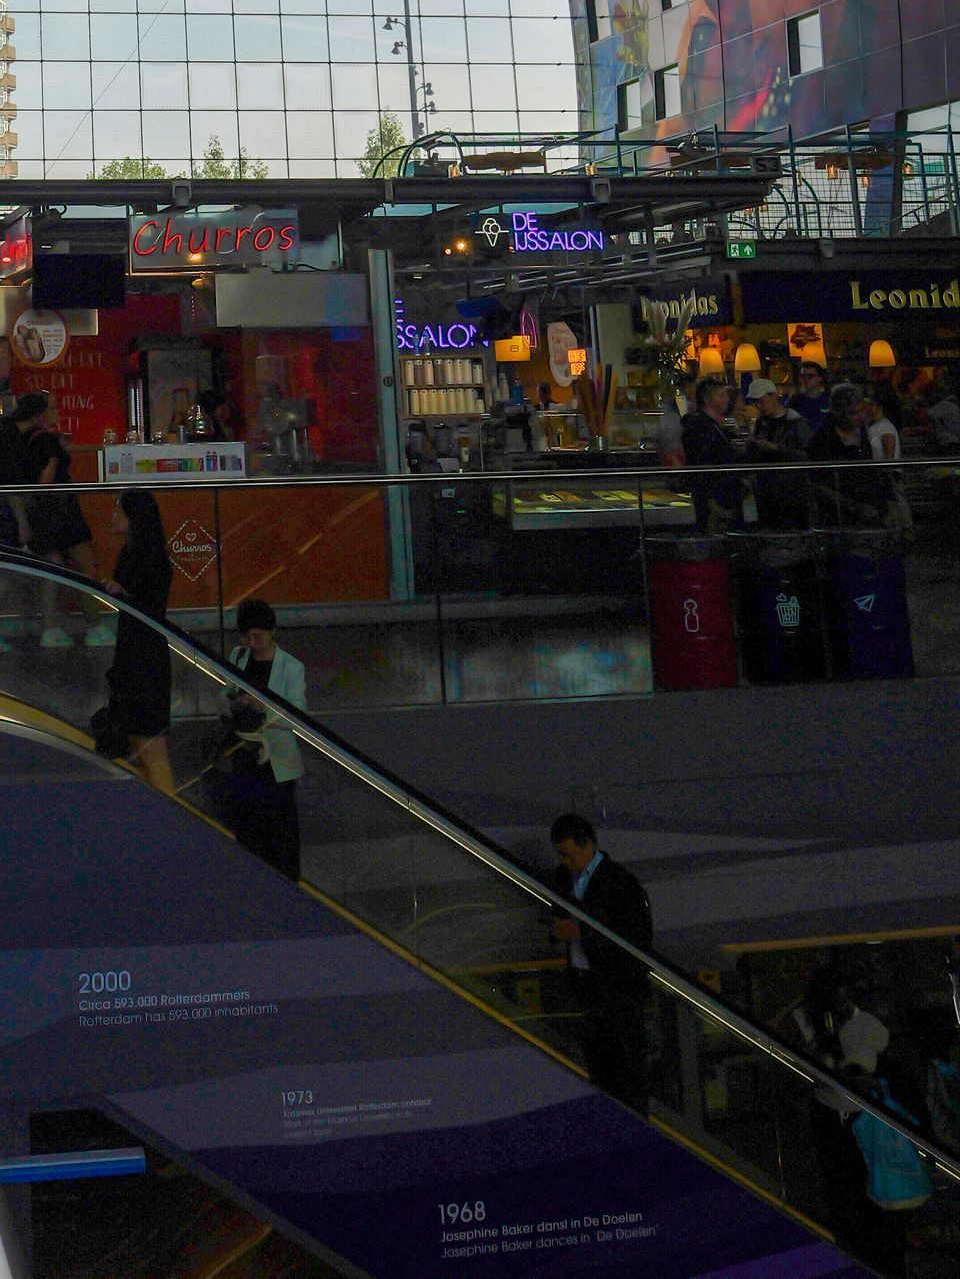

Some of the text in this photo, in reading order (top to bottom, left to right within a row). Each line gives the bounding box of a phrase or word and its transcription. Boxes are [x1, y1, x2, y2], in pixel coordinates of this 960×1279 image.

[513, 213, 538, 231] DE
[134, 218, 296, 255] Churros
[514, 232, 603, 250] IJSSALON
[172, 540, 211, 553] Churros
[78, 971, 131, 994] 2000
[79, 991, 250, 1011] Circa 593.000 Rotterdammers
[79, 1002, 279, 1027] Rotterdam has 593.000 inhabitants
[281, 1090, 313, 1106] 1973
[438, 1200, 487, 1225] 1968
[440, 1212, 643, 1242] Josephine Baker danst in De Doelen
[441, 1243, 498, 1258] Josephine
[502, 1240, 533, 1252] Baker
[536, 1234, 578, 1248] dances
[580, 1232, 590, 1243] in
